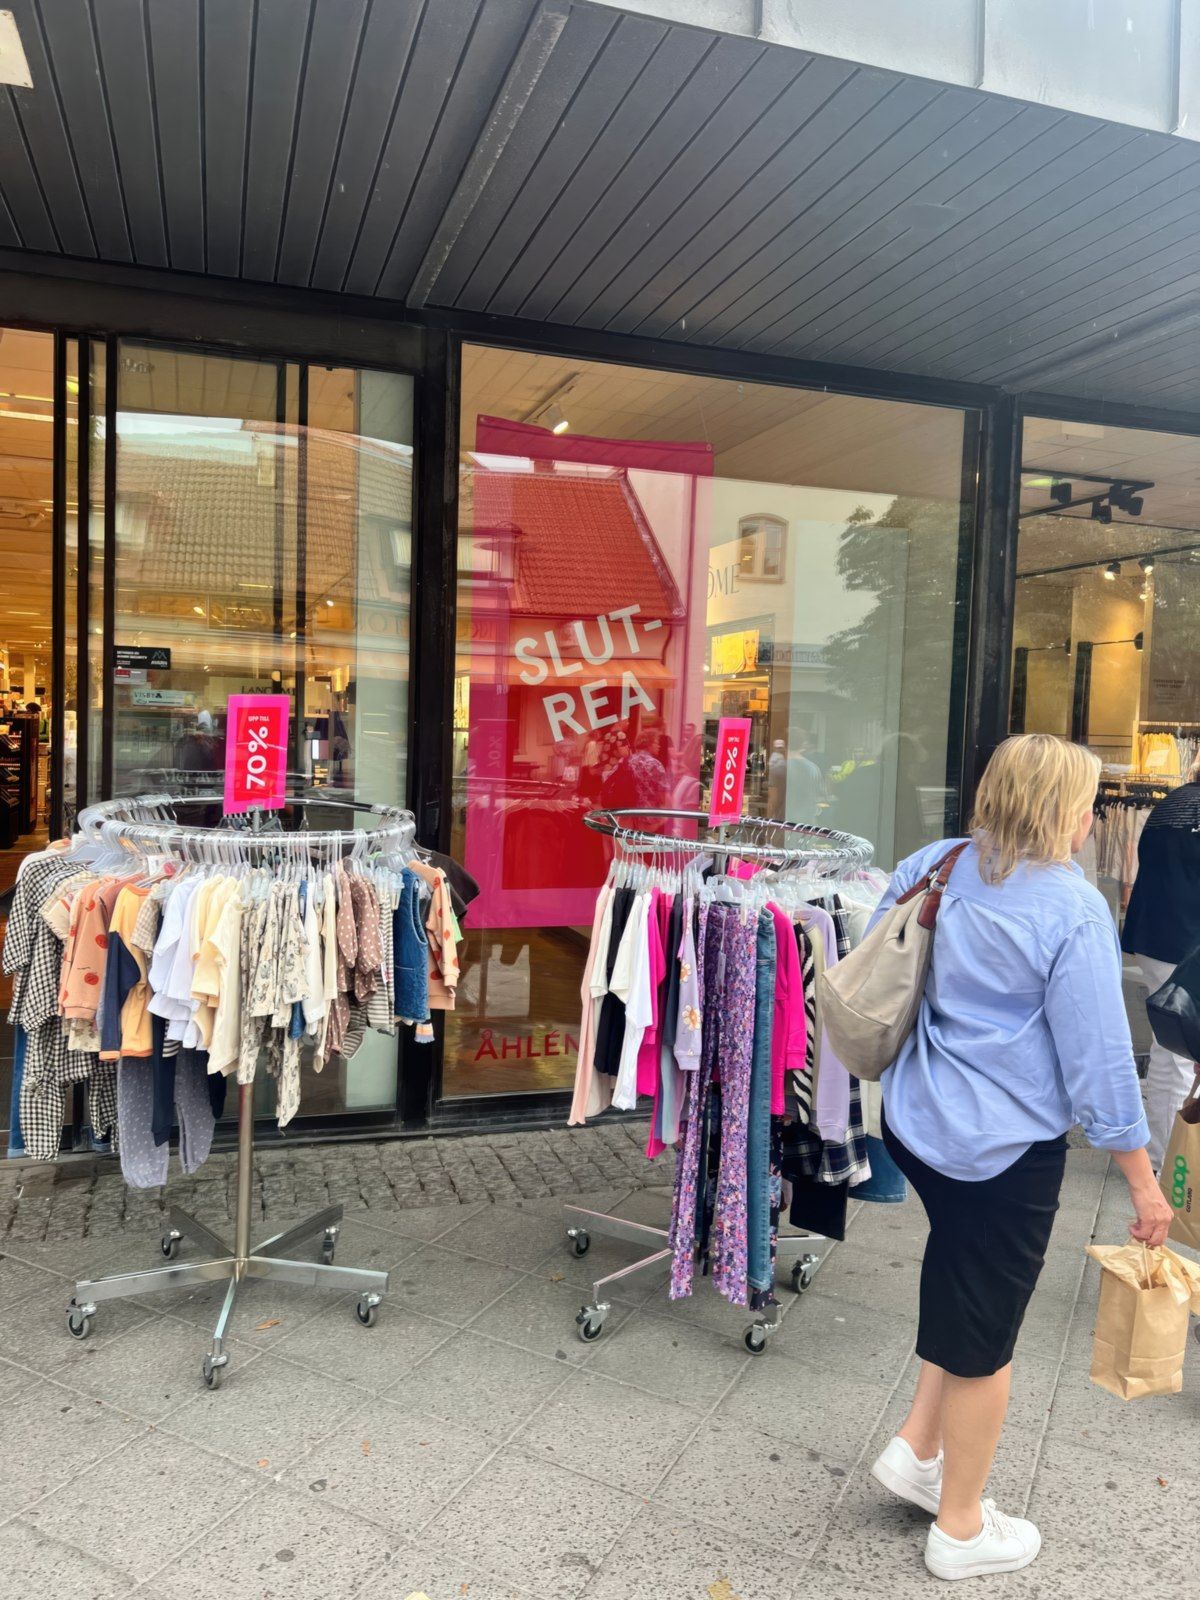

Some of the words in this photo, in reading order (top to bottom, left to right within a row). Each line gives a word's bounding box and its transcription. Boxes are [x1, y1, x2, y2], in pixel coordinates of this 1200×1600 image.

[515, 604, 662, 685] SLUT-
[542, 671, 656, 742] REA
[246, 726, 268, 790] 70%
[722, 746, 738, 805] 70%
[1172, 1154, 1189, 1208] coop
